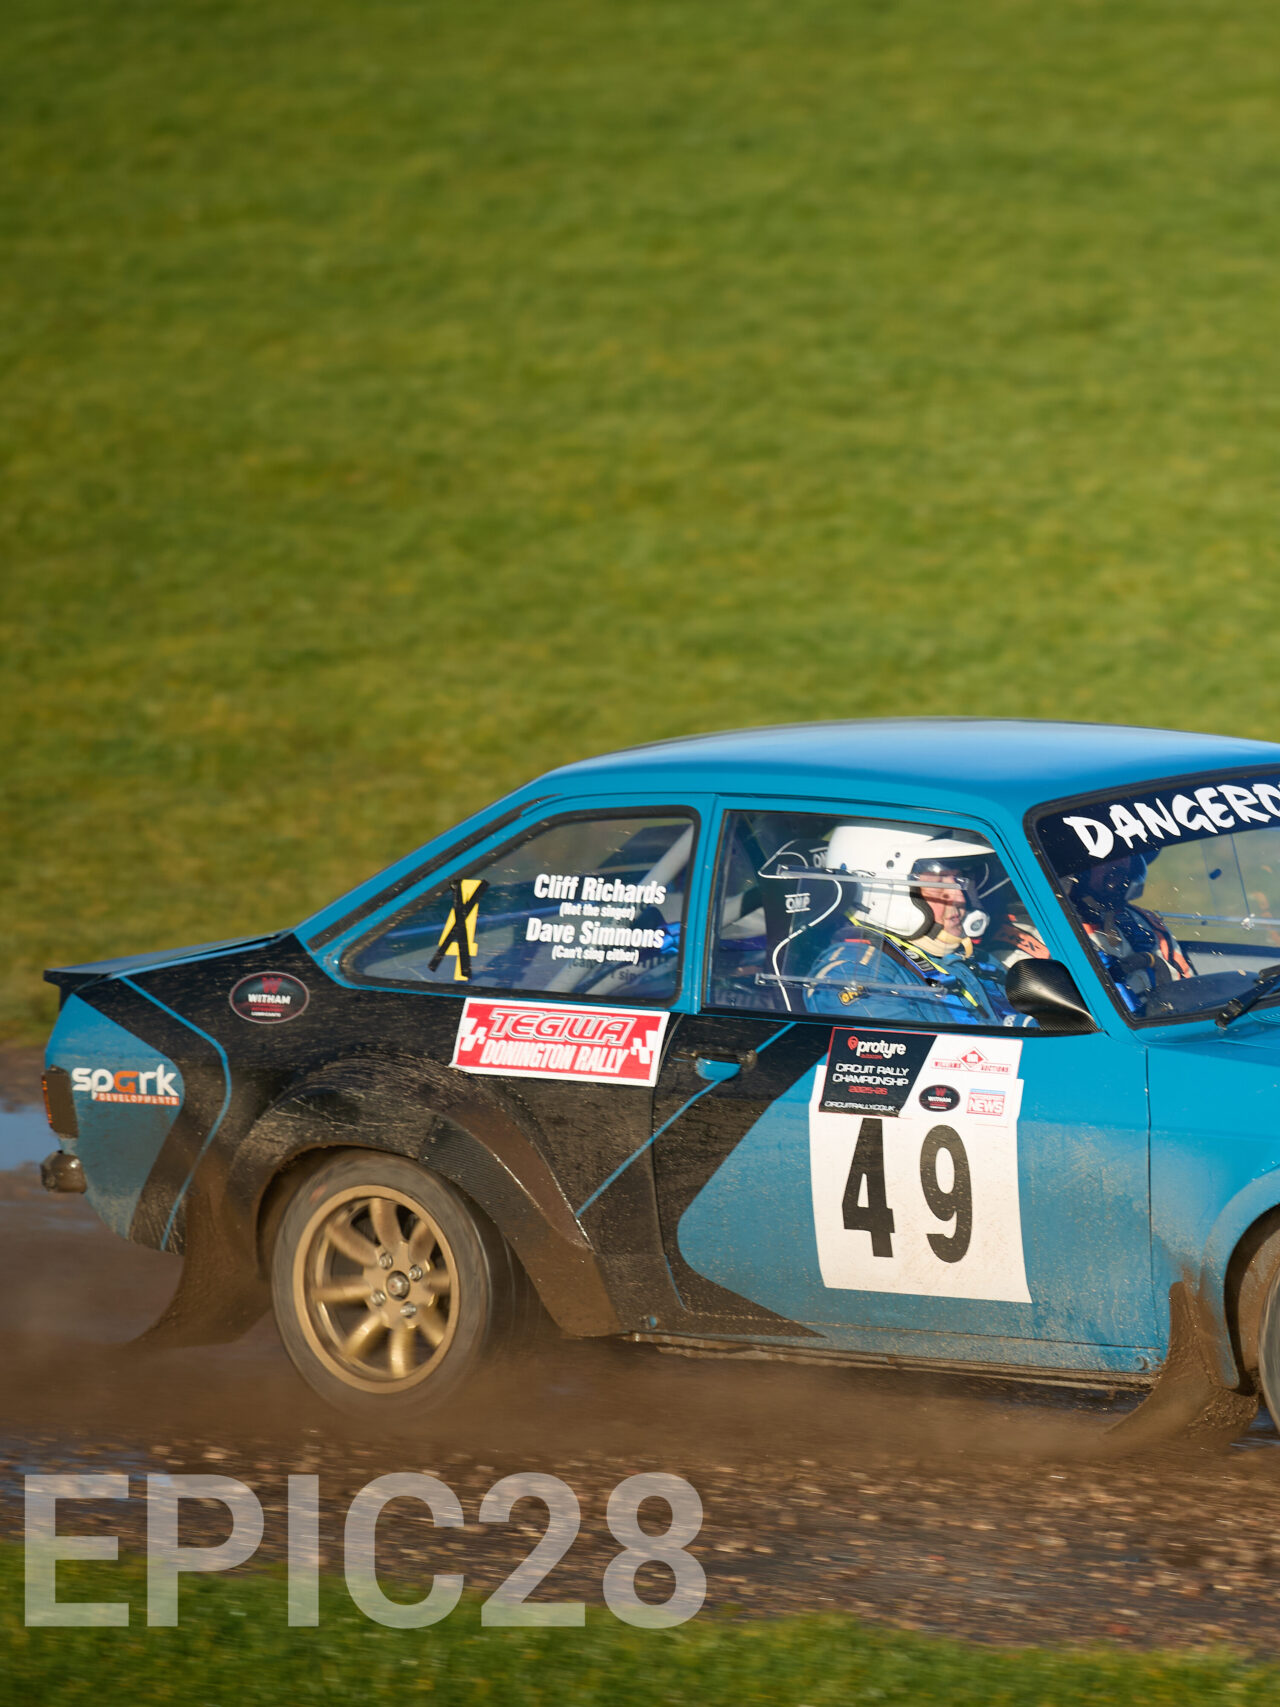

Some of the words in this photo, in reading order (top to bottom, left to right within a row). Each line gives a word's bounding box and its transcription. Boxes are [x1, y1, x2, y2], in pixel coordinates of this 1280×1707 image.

[534, 873, 580, 900] Cliff
[580, 876, 667, 905] Richards
[582, 903, 600, 917] the
[600, 904, 636, 921] singer)
[525, 917, 576, 944] Dave
[579, 920, 666, 949] Simmons
[582, 947, 606, 963] sing
[605, 948, 640, 965] either)
[247, 993, 292, 1005] WITHAM
[479, 1039, 577, 1071] DONINGTON
[573, 1045, 630, 1074] RALLY
[856, 1039, 907, 1059] protyre
[835, 1062, 877, 1074] CIRCUIT
[876, 1065, 910, 1077] RALLY
[832, 1073, 910, 1087] CHAMPIONSHIP
[98, 1092, 179, 1105] DEVELOPMENTS
[968, 1096, 1004, 1114] NEWS
[841, 1117, 973, 1264] 49
